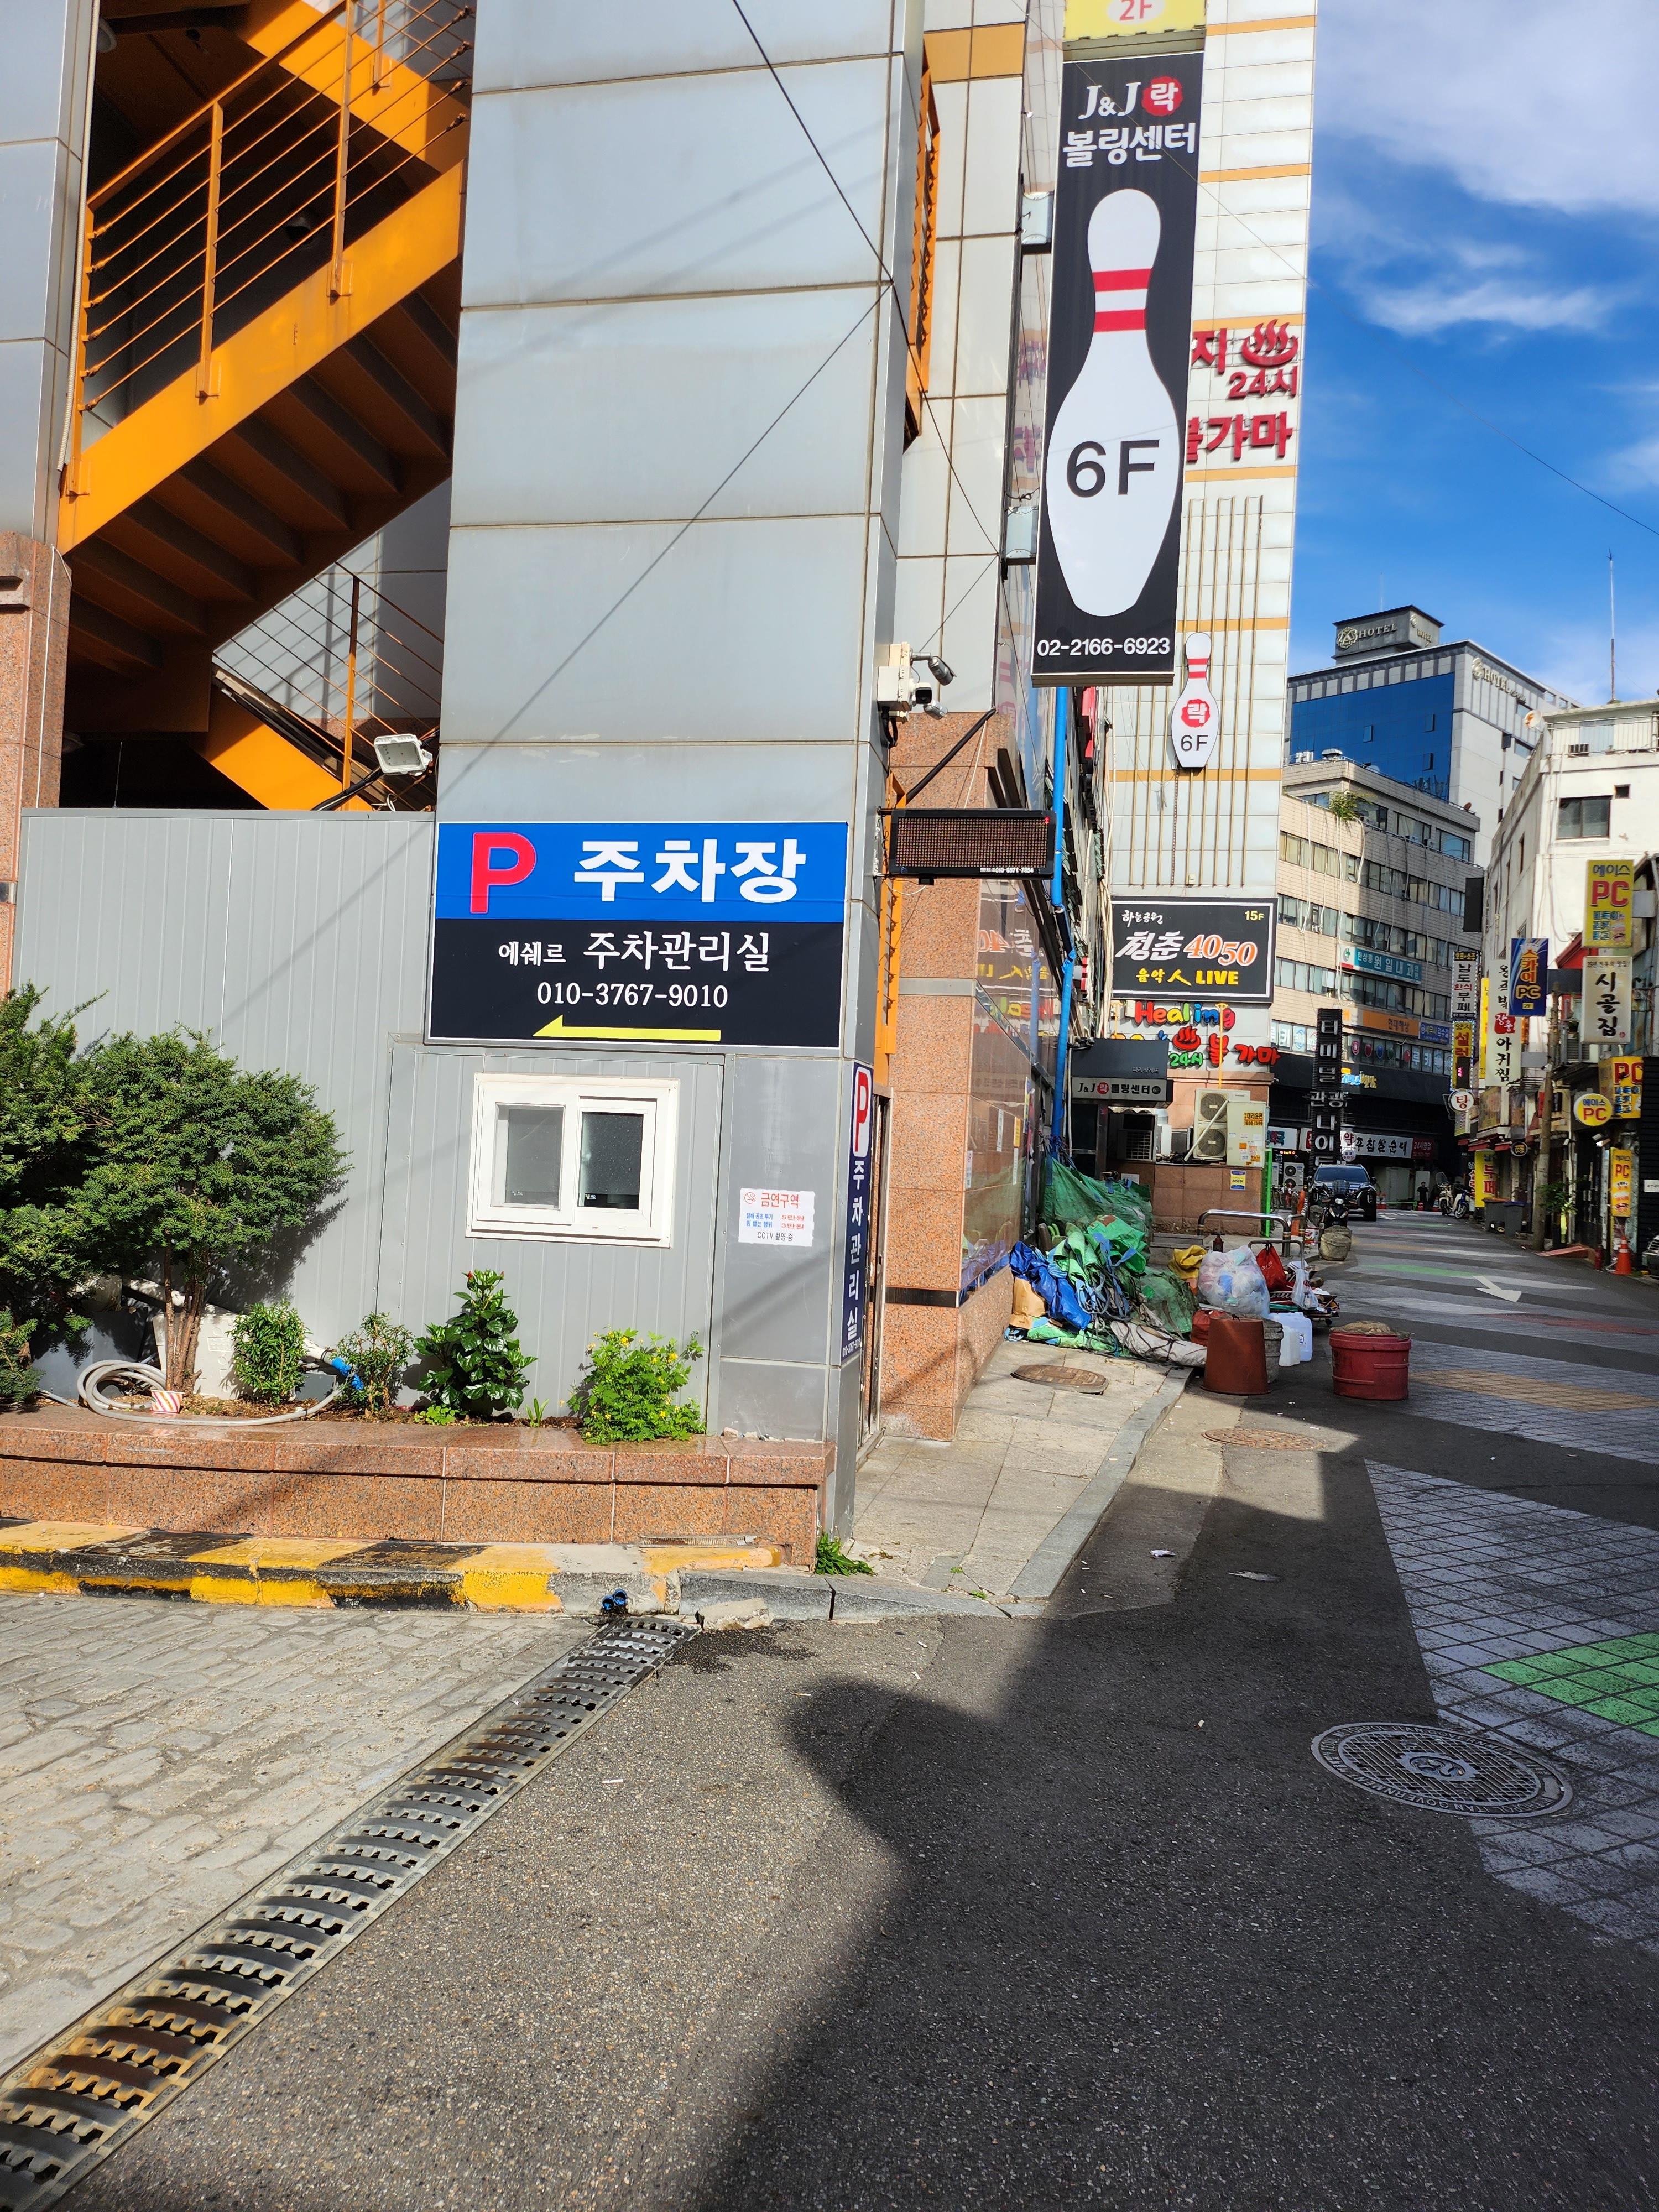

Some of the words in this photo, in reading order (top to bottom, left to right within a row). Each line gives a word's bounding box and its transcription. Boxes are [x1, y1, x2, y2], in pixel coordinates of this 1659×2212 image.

[1119, 0, 1154, 22] 2F
[1150, 84, 1179, 111] 락
[1063, 122, 1196, 168] 볼링센터
[1228, 366, 1298, 398] 24시
[1066, 439, 1160, 497] 6F
[1358, 623, 1398, 638] HOTEL
[1037, 637, 1171, 656] 02-2166-6923
[1180, 734, 1209, 752] 6F
[469, 832, 538, 914] P
[573, 838, 806, 904] 주차장
[1593, 864, 1630, 877] 에이스
[1591, 880, 1629, 907] PC
[1121, 910, 1163, 927] 하늘공원
[1244, 911, 1264, 921] 15F
[498, 941, 566, 967] 에쉐르
[583, 931, 769, 972] 주차관리실
[1115, 931, 1185, 961] 청춘
[1183, 934, 1258, 967] 4050
[1457, 963, 1472, 983] 남도
[1520, 948, 1539, 984] 스카이
[1196, 970, 1239, 985] LIVE
[1454, 983, 1472, 992] 한식
[537, 981, 728, 1008] 010-3767-9010
[1456, 992, 1471, 1012] 부페
[1516, 984, 1541, 999] PC
[1135, 1000, 1236, 1029] Healing
[1595, 972, 1621, 1037] 시골집
[1495, 1036, 1512, 1082] 아귀찜
[1614, 1062, 1644, 1085] PC
[855, 1070, 870, 1152] P
[1455, 1094, 1470, 1109] 탕
[1583, 1107, 1607, 1121] PC
[1344, 1133, 1354, 1146] 약
[1615, 1164, 1630, 1178] PC
[761, 1193, 799, 1209] 금연구역
[788, 1233, 793, 1241] 중
[847, 1160, 865, 1341] 주차관리실
